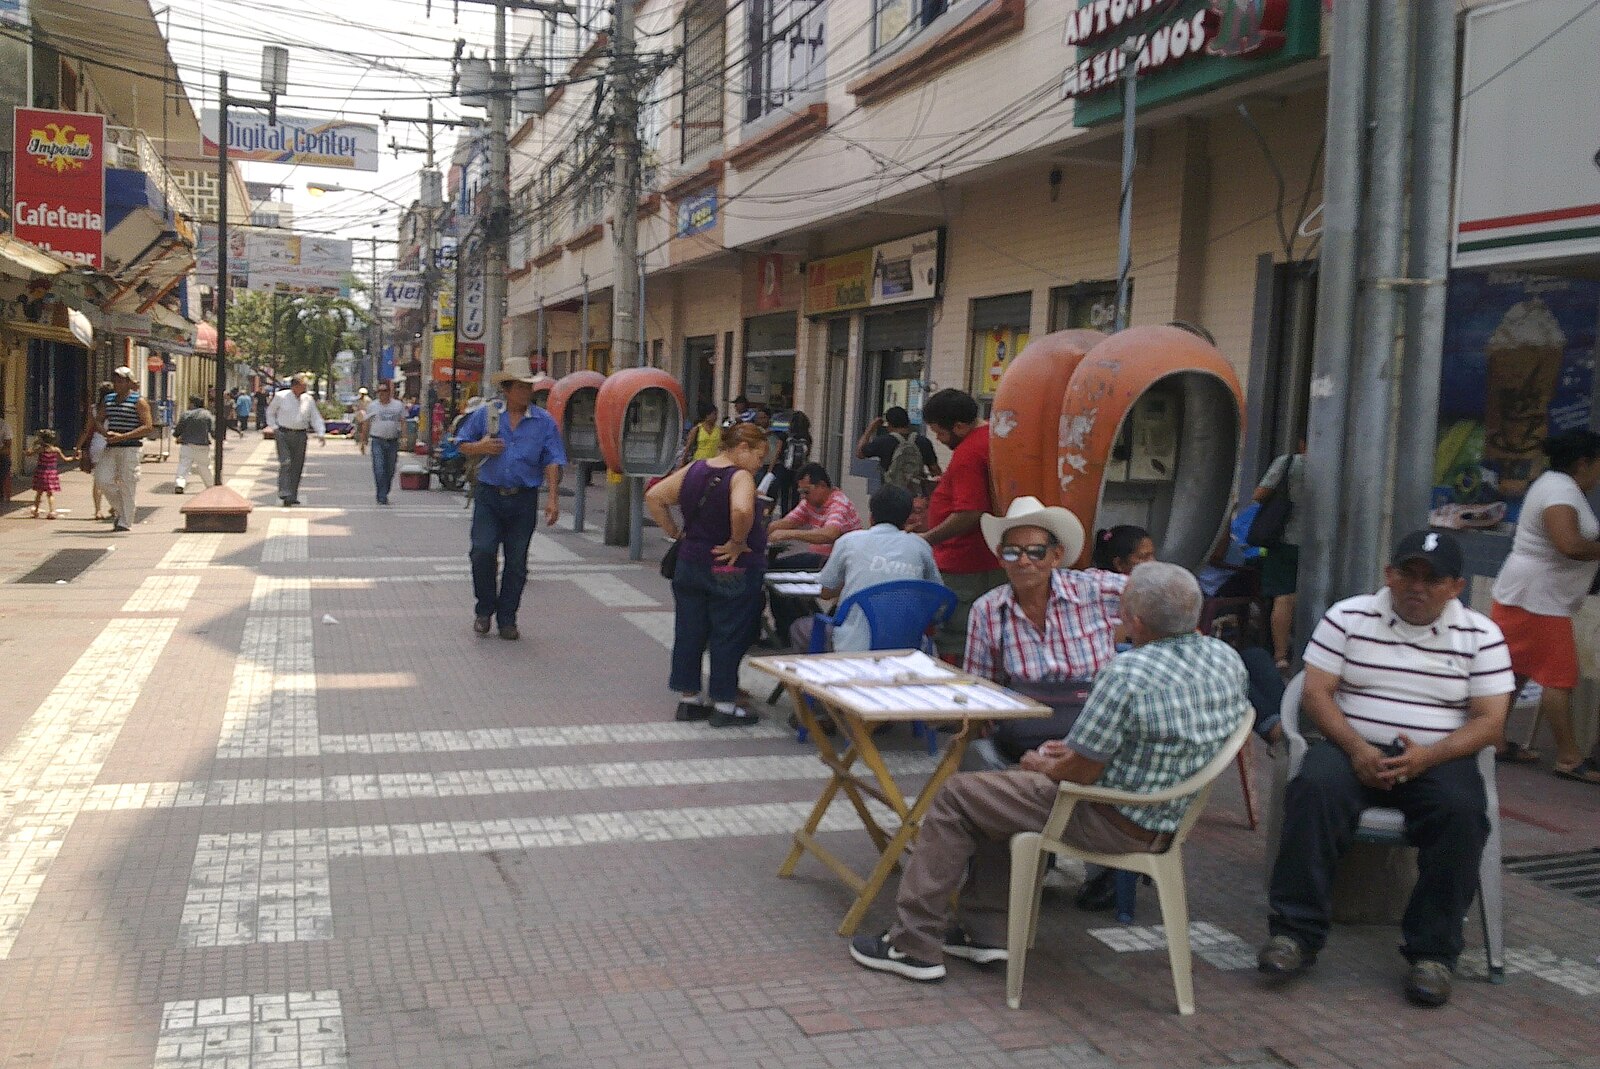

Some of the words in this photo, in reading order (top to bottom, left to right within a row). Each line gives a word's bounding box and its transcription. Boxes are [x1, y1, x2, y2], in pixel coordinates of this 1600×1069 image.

[226, 119, 286, 152] Digital
[293, 126, 356, 157] Center
[15, 201, 102, 231] Cafeteria
